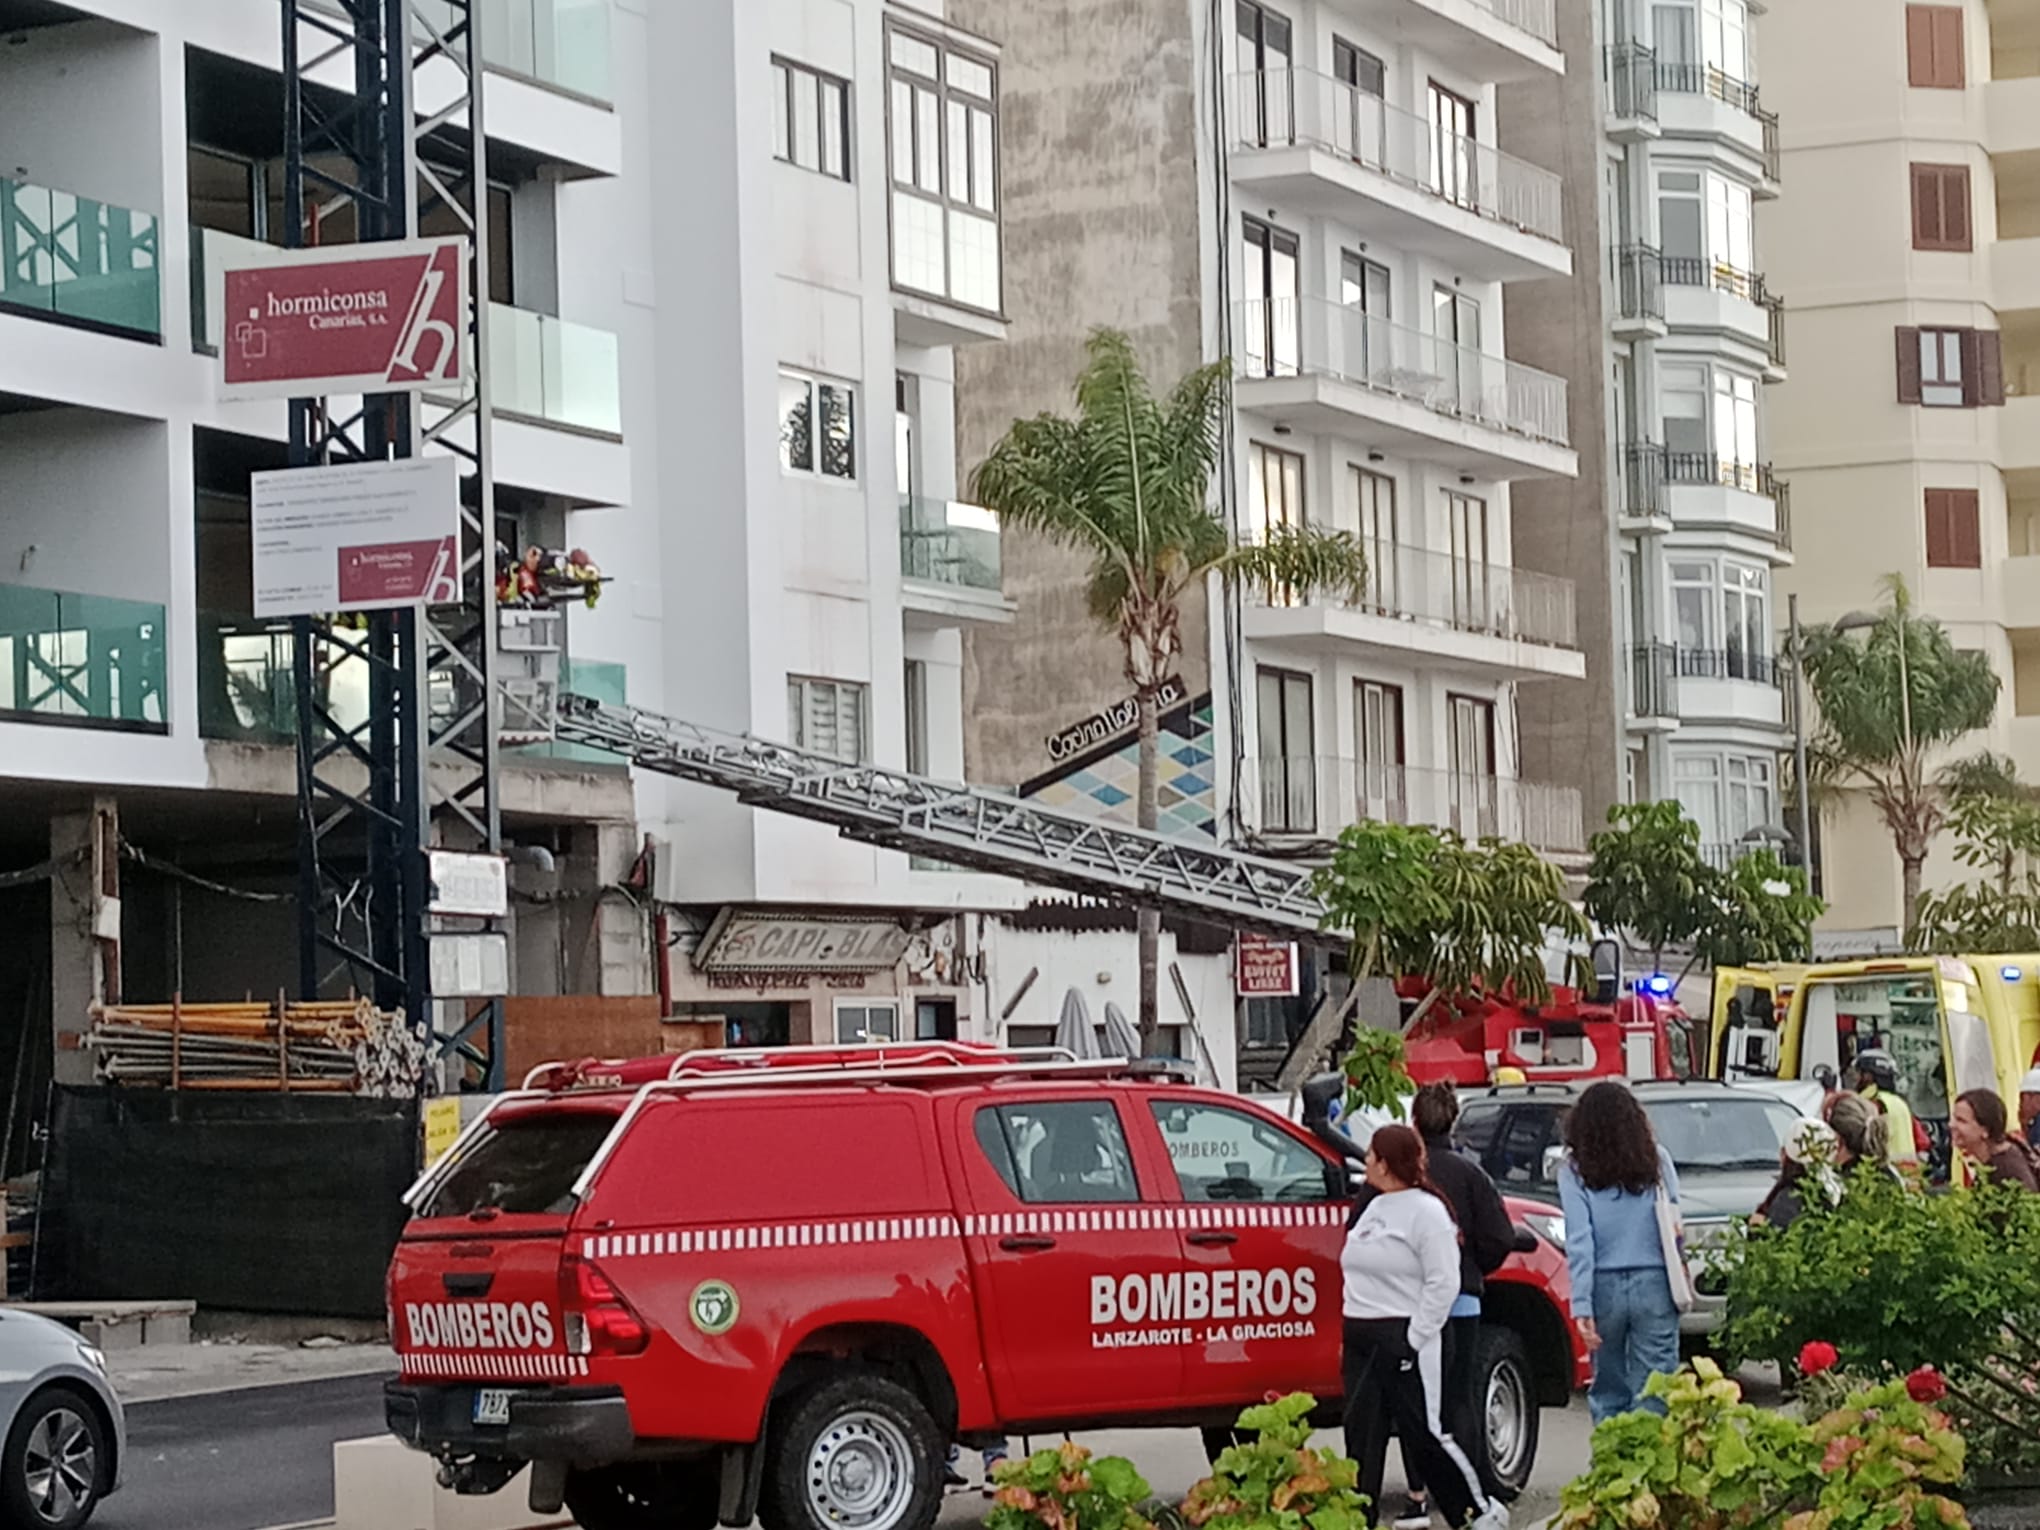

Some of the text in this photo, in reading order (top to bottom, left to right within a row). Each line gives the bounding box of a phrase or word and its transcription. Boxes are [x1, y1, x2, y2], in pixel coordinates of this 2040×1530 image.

[267, 287, 388, 317] hormiconsa
[1047, 716, 1107, 759] Cocina
[756, 927, 828, 959] CAPI
[1167, 1141, 1240, 1158] OMBEROS
[1091, 1266, 1317, 1324] BOMBEROS
[405, 1301, 554, 1348] BOMBEROS
[1092, 1320, 1316, 1349] LANZAROTE LA GRACIOSA
